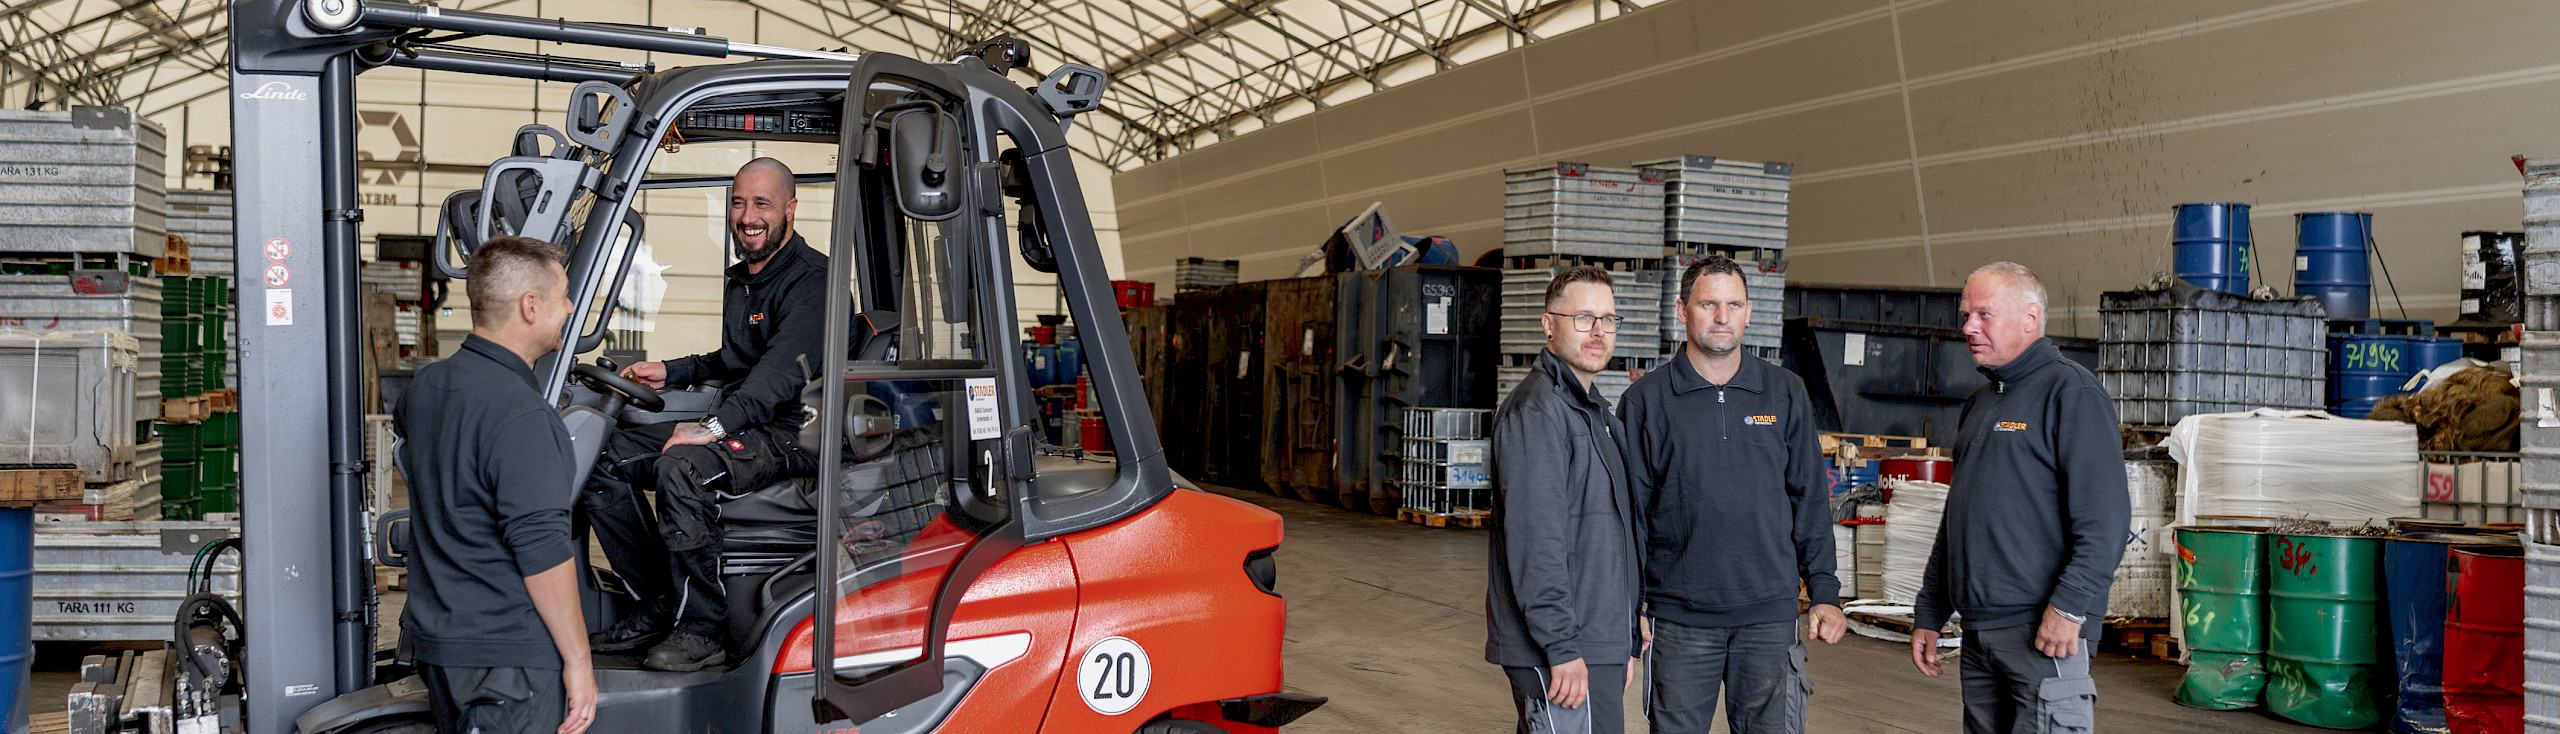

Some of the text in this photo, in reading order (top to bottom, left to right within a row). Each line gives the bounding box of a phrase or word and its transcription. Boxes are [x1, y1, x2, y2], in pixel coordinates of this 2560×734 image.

[240, 81, 307, 100] Linde
[0, 166, 60, 176] ARA 131 KG
[974, 385, 996, 397] STADLER
[984, 449, 997, 497] 2
[2427, 471, 2454, 500] 59
[58, 602, 134, 613] TARA 111 KG
[1093, 651, 1136, 700] 20
